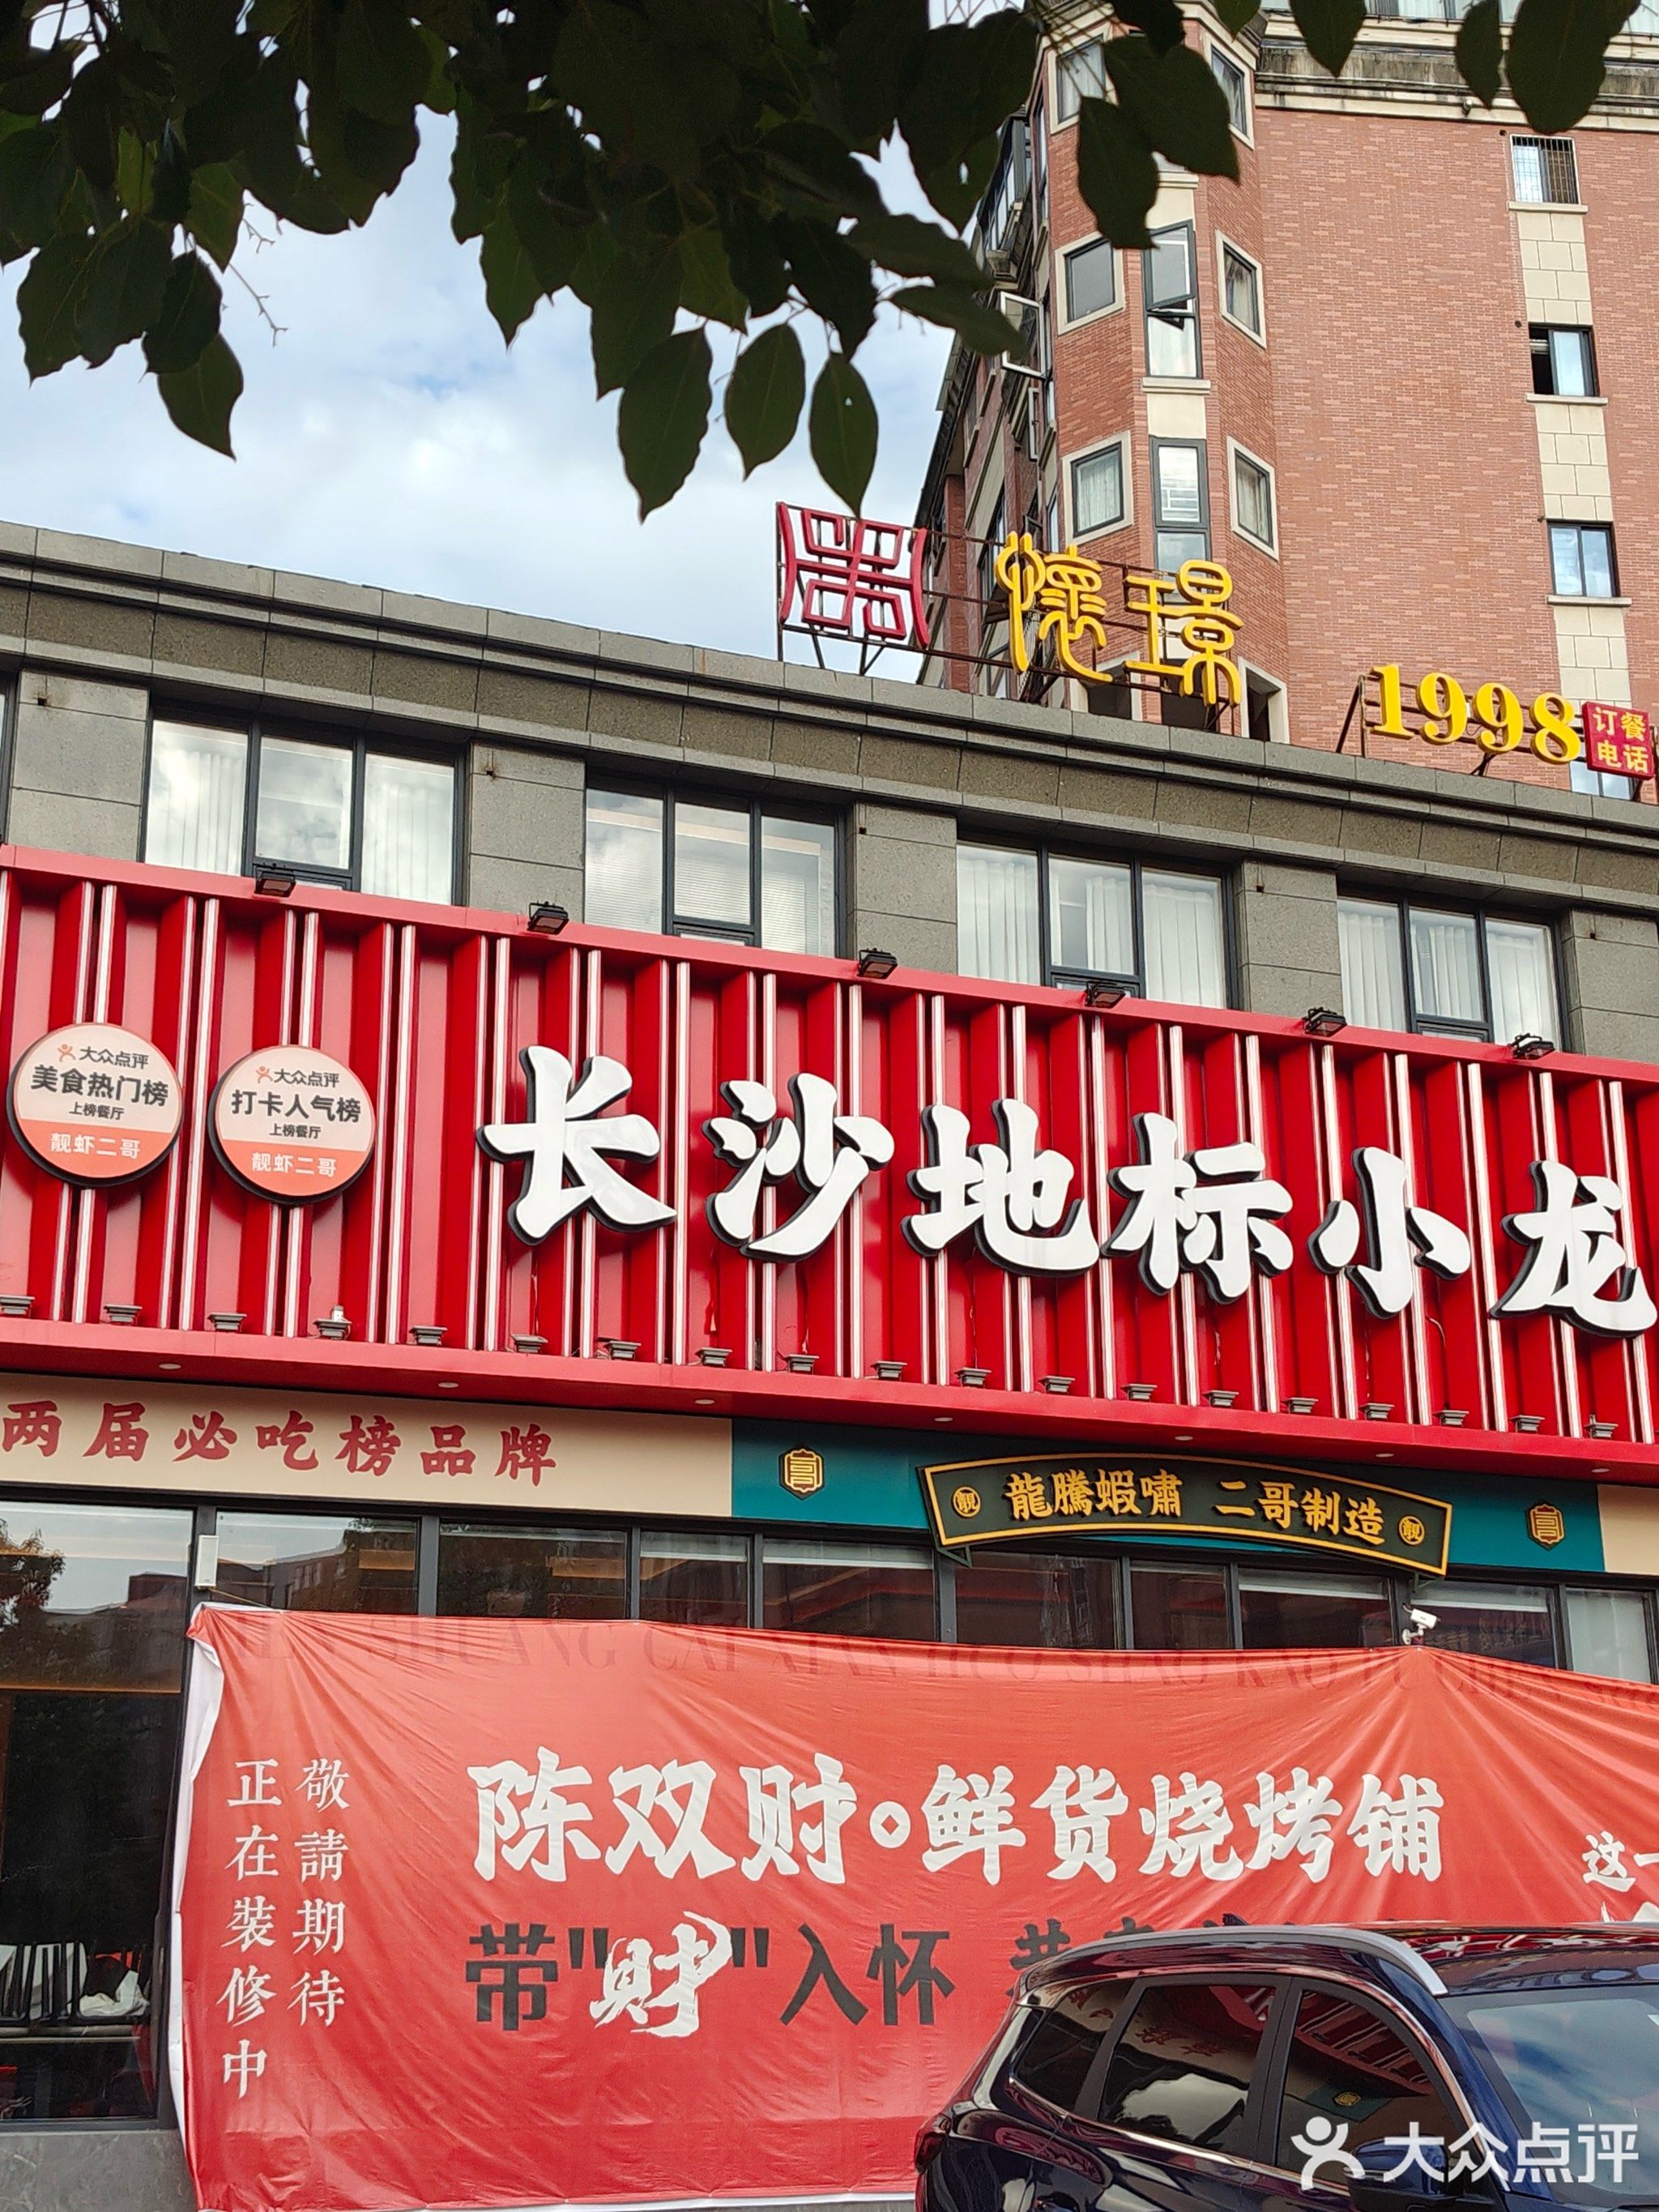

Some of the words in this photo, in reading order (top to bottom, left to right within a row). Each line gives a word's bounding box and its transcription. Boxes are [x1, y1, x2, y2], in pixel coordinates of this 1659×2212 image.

[1369, 663, 1581, 764] 1998
[1592, 706, 1646, 741] 订餐
[1597, 739, 1649, 774] 电话
[79, 1046, 149, 1070] 大众点评
[30, 1065, 168, 1108] 美食热门榜
[274, 1068, 340, 1088] 大众点评
[69, 1101, 125, 1121] 上榜餐厅
[231, 1089, 361, 1124] 打卡人气榜
[50, 1132, 142, 1159] 靓虾二哥
[269, 1123, 322, 1139] 上榜餐厅
[251, 1151, 337, 1178] 靓虾二哥
[478, 1044, 1658, 1337] 长沙地标小龙
[2, 1399, 557, 1487] 两届必吃榜品牌
[1213, 1479, 1386, 1545] 二哥制造
[287, 1757, 351, 2027] 敬請期待
